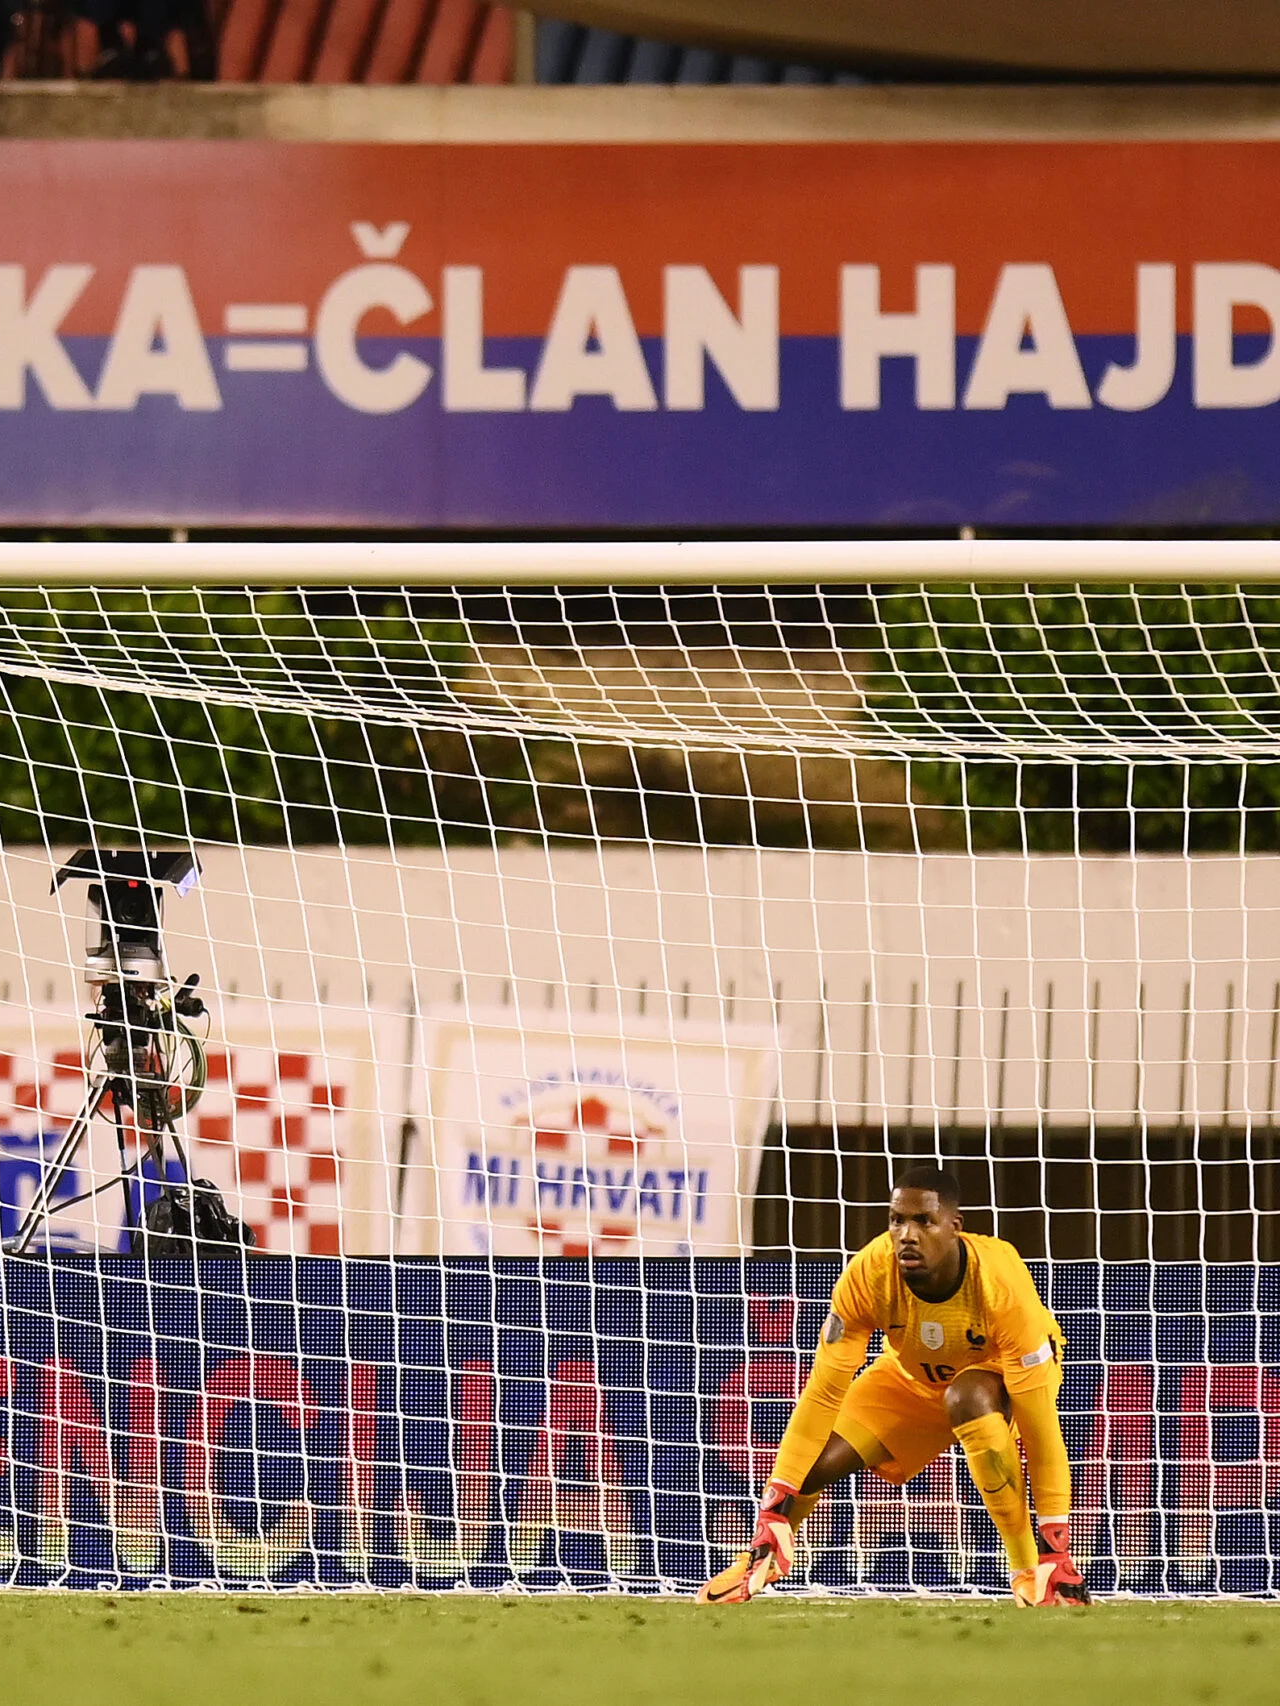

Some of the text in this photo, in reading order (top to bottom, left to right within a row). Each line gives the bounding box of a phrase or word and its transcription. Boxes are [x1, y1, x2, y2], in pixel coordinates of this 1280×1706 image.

[840, 262, 1280, 412] HAJD
[466, 1151, 709, 1225] MI HRVATI
